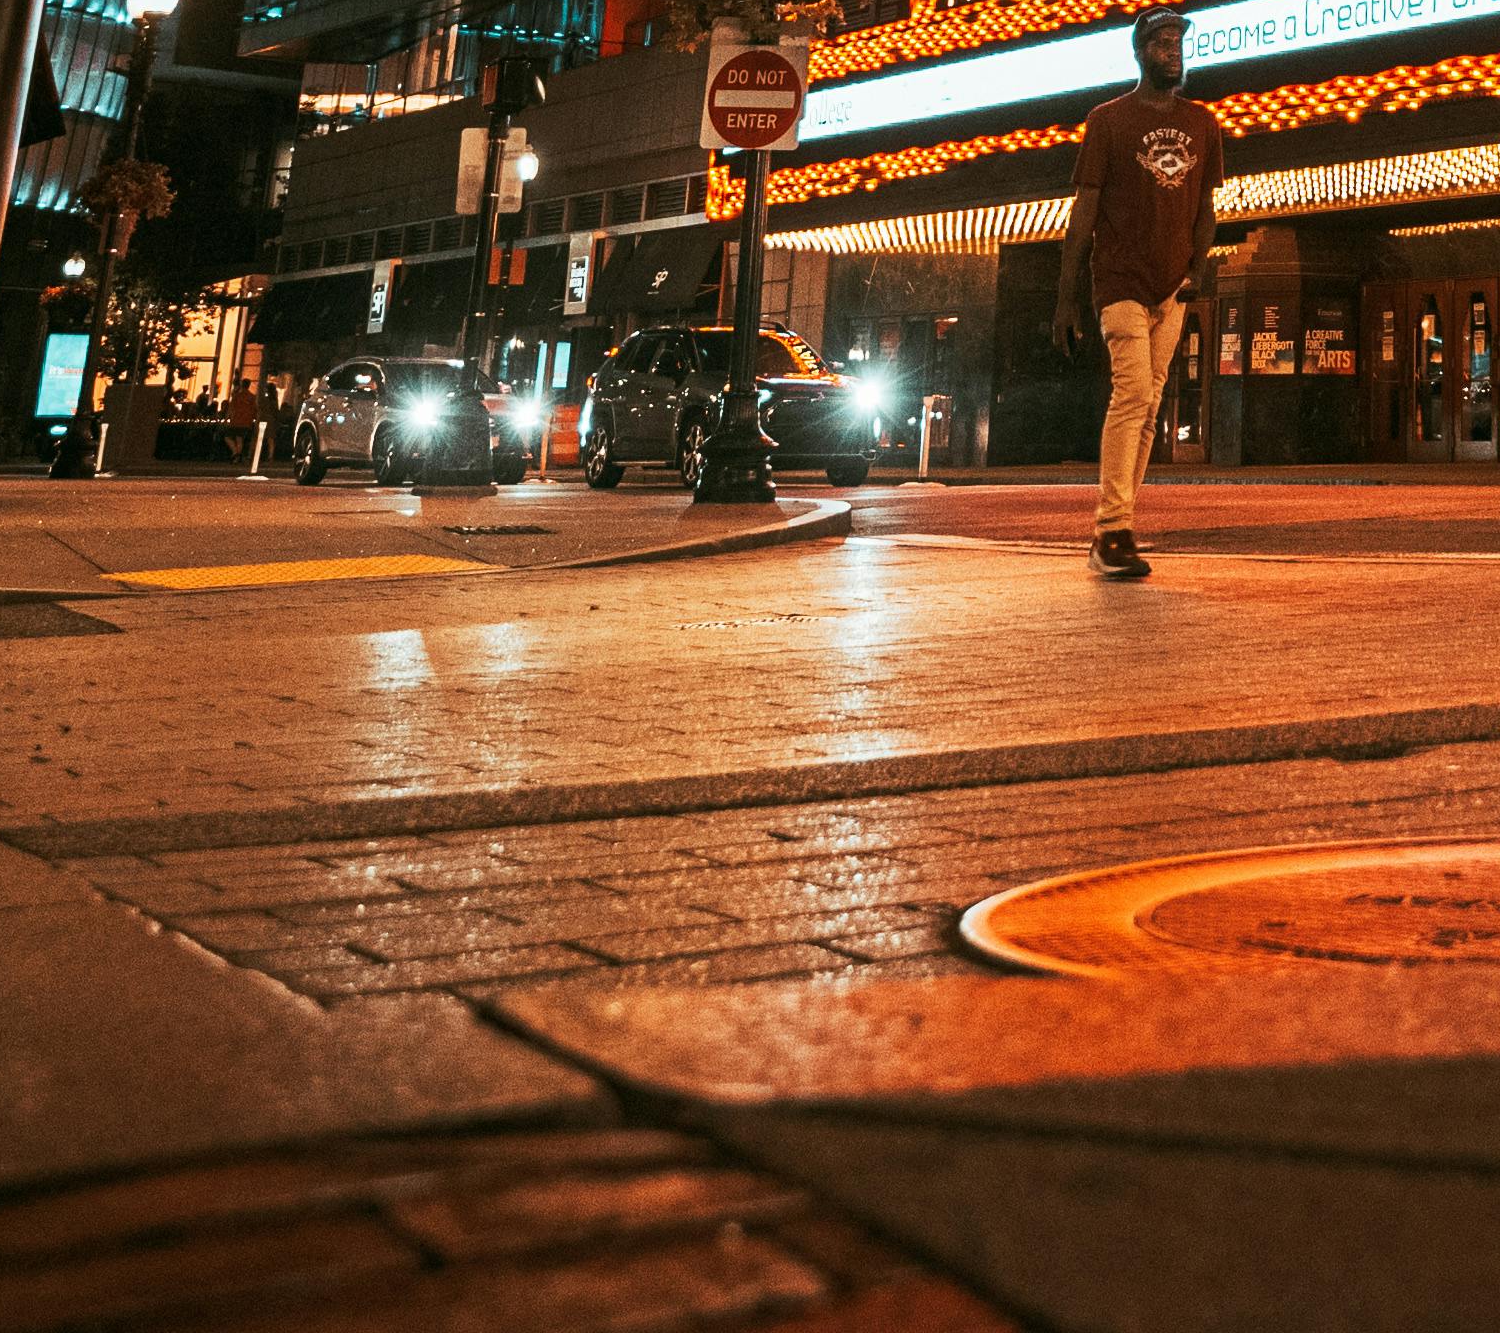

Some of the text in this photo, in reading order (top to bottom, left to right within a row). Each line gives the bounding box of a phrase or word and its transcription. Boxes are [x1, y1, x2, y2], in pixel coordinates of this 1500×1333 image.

[1183, 20, 1276, 60] Become
[1284, 16, 1297, 40] a
[728, 69, 788, 85] DO NOT
[726, 113, 778, 129] ENTER
[1142, 128, 1193, 146] FASTEST
[1305, 340, 1326, 350] FORCE
[1252, 351, 1276, 360] BLACK
[1317, 351, 1350, 368] ARTS
